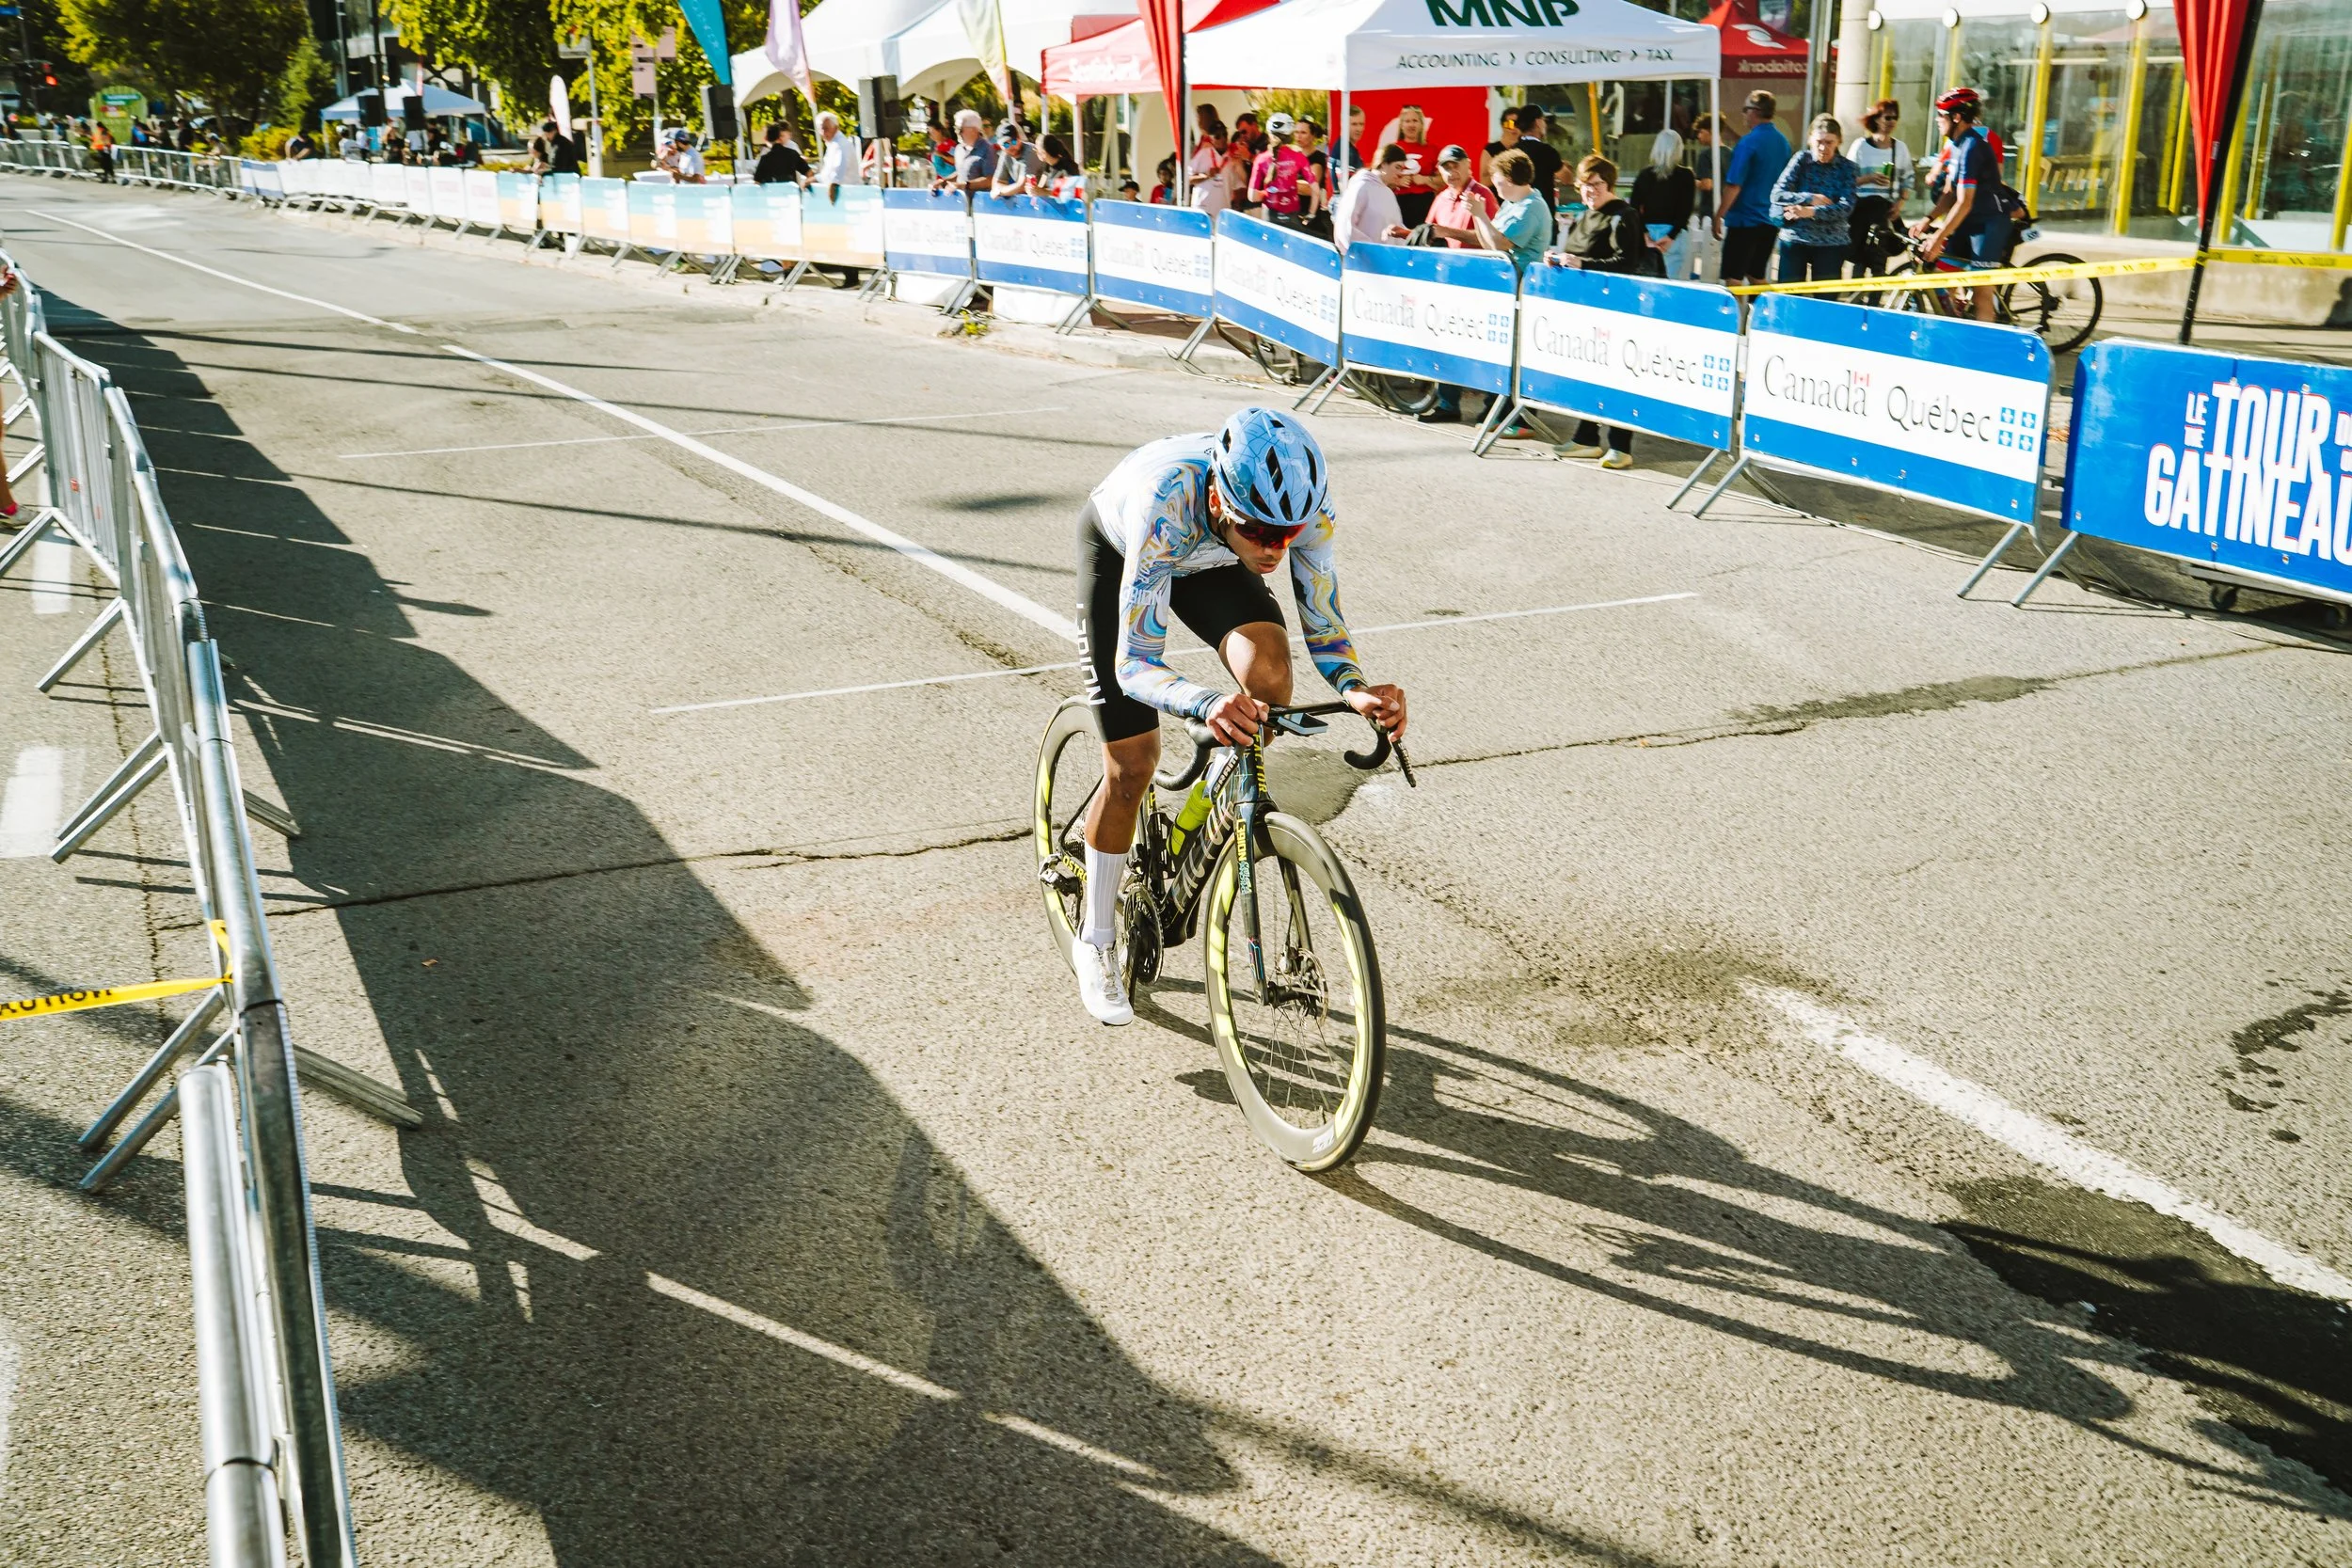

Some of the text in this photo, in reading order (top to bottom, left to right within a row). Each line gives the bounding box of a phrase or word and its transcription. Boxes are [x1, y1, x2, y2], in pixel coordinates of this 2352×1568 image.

[1425, 0, 1581, 26] MNP
[1396, 47, 1674, 69] ACCOUNTING CONSULTING TAX
[1220, 251, 1268, 295] Canada
[1352, 286, 1416, 329] Canada
[1533, 315, 1610, 367] Canada
[1764, 354, 1992, 442] Canada Québec
[2185, 390, 2210, 426] LE
[2212, 381, 2331, 483] TOUR
[1213, 753, 1240, 795] SRAM
[1251, 734, 1267, 793] FACTOR
[1171, 786, 1235, 914] FACTOR
